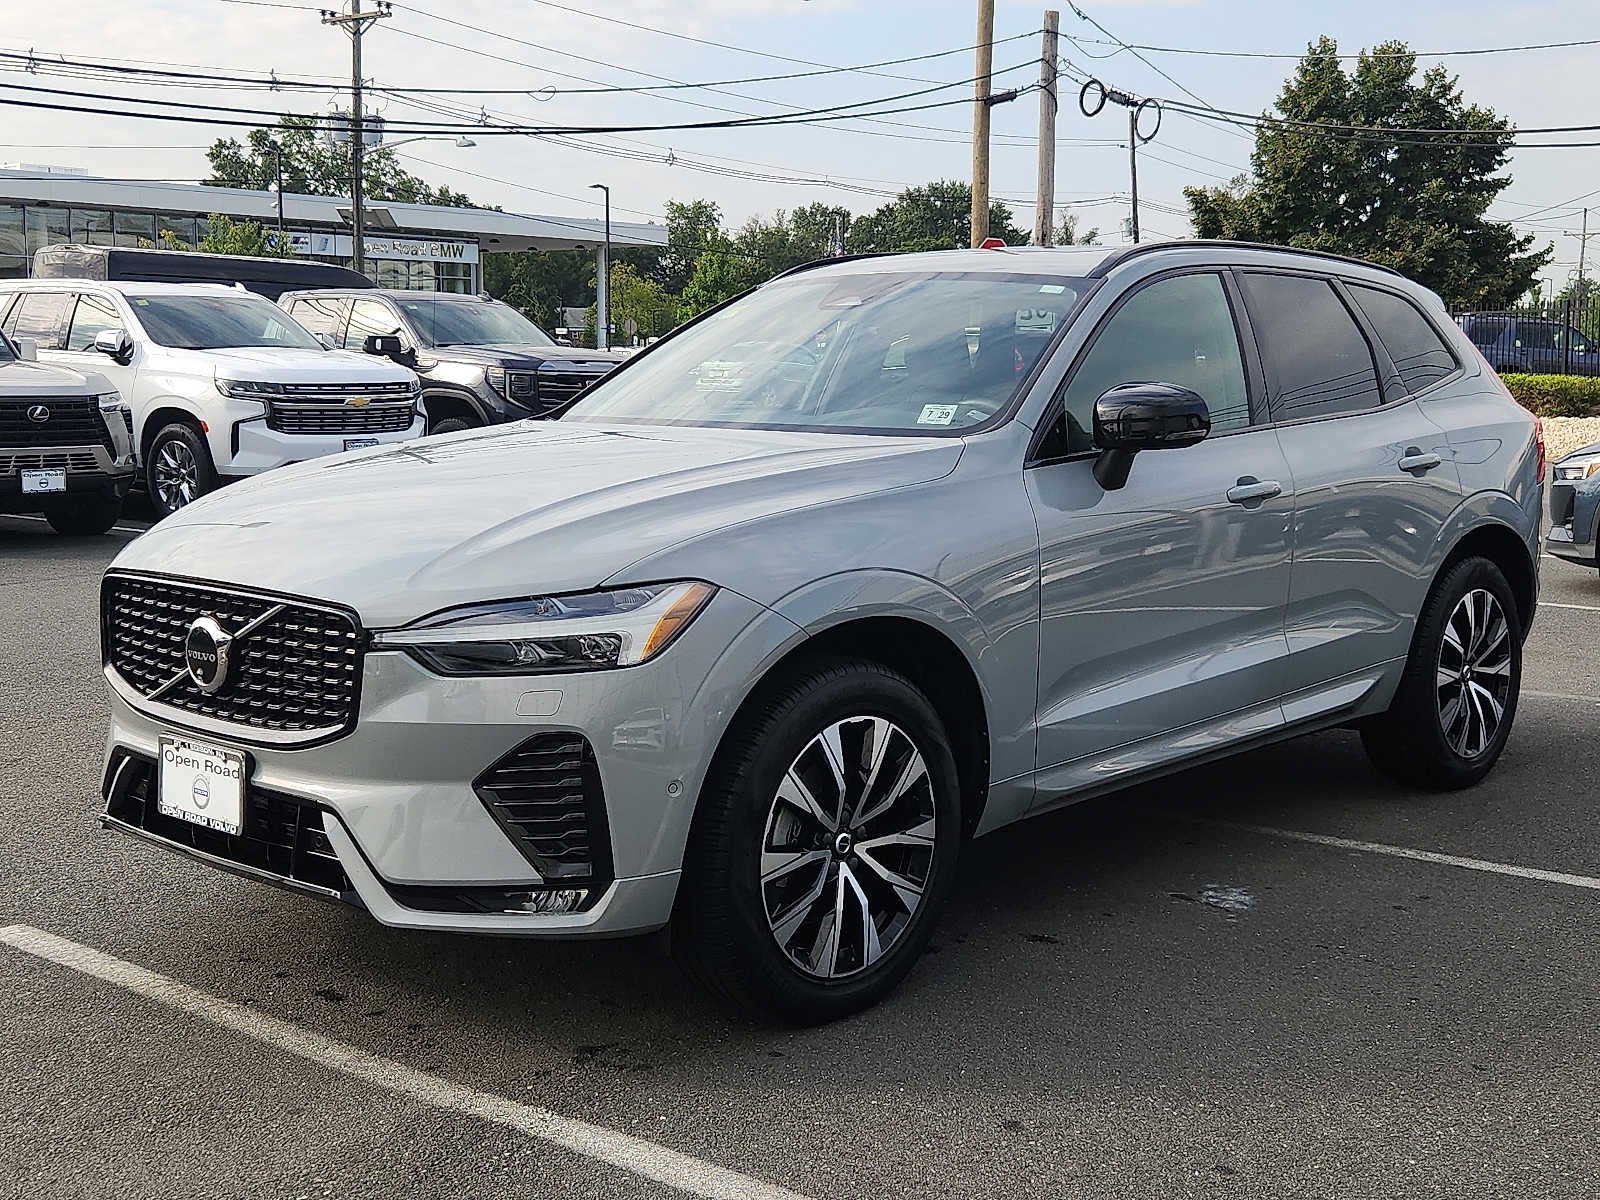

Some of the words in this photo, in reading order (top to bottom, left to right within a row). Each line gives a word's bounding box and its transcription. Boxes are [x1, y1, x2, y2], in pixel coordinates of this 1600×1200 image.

[363, 242, 389, 255] pen
[392, 240, 427, 256] Road
[429, 242, 465, 258] BMW
[926, 410, 934, 419] 7
[938, 410, 951, 419] 29
[188, 649, 216, 663] VOLVO
[164, 749, 200, 769] Open
[204, 759, 240, 779] Road
[161, 805, 184, 819] OPEN
[184, 811, 208, 826] ROAD
[209, 818, 237, 834] VOLVO
